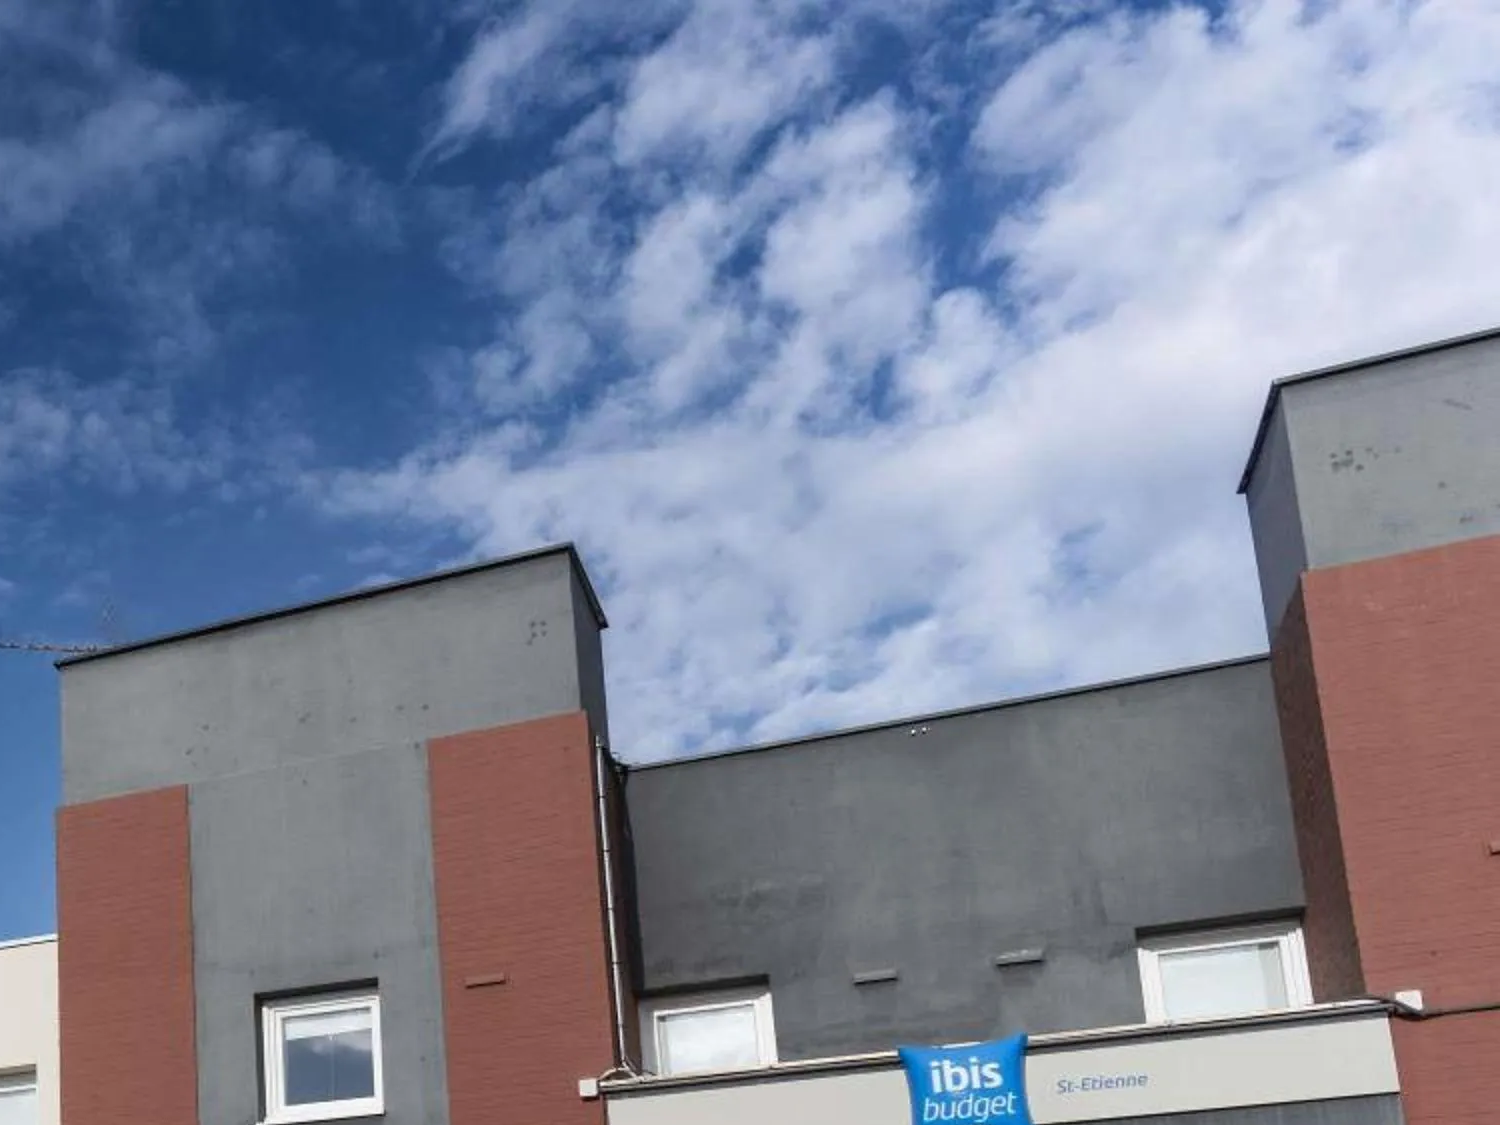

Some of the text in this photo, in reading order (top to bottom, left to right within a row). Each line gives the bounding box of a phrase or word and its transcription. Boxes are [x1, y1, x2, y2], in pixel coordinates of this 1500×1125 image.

[930, 1056, 1003, 1093] ibis
[1056, 1073, 1149, 1095] St-Etienne
[922, 1090, 1017, 1123] budget
